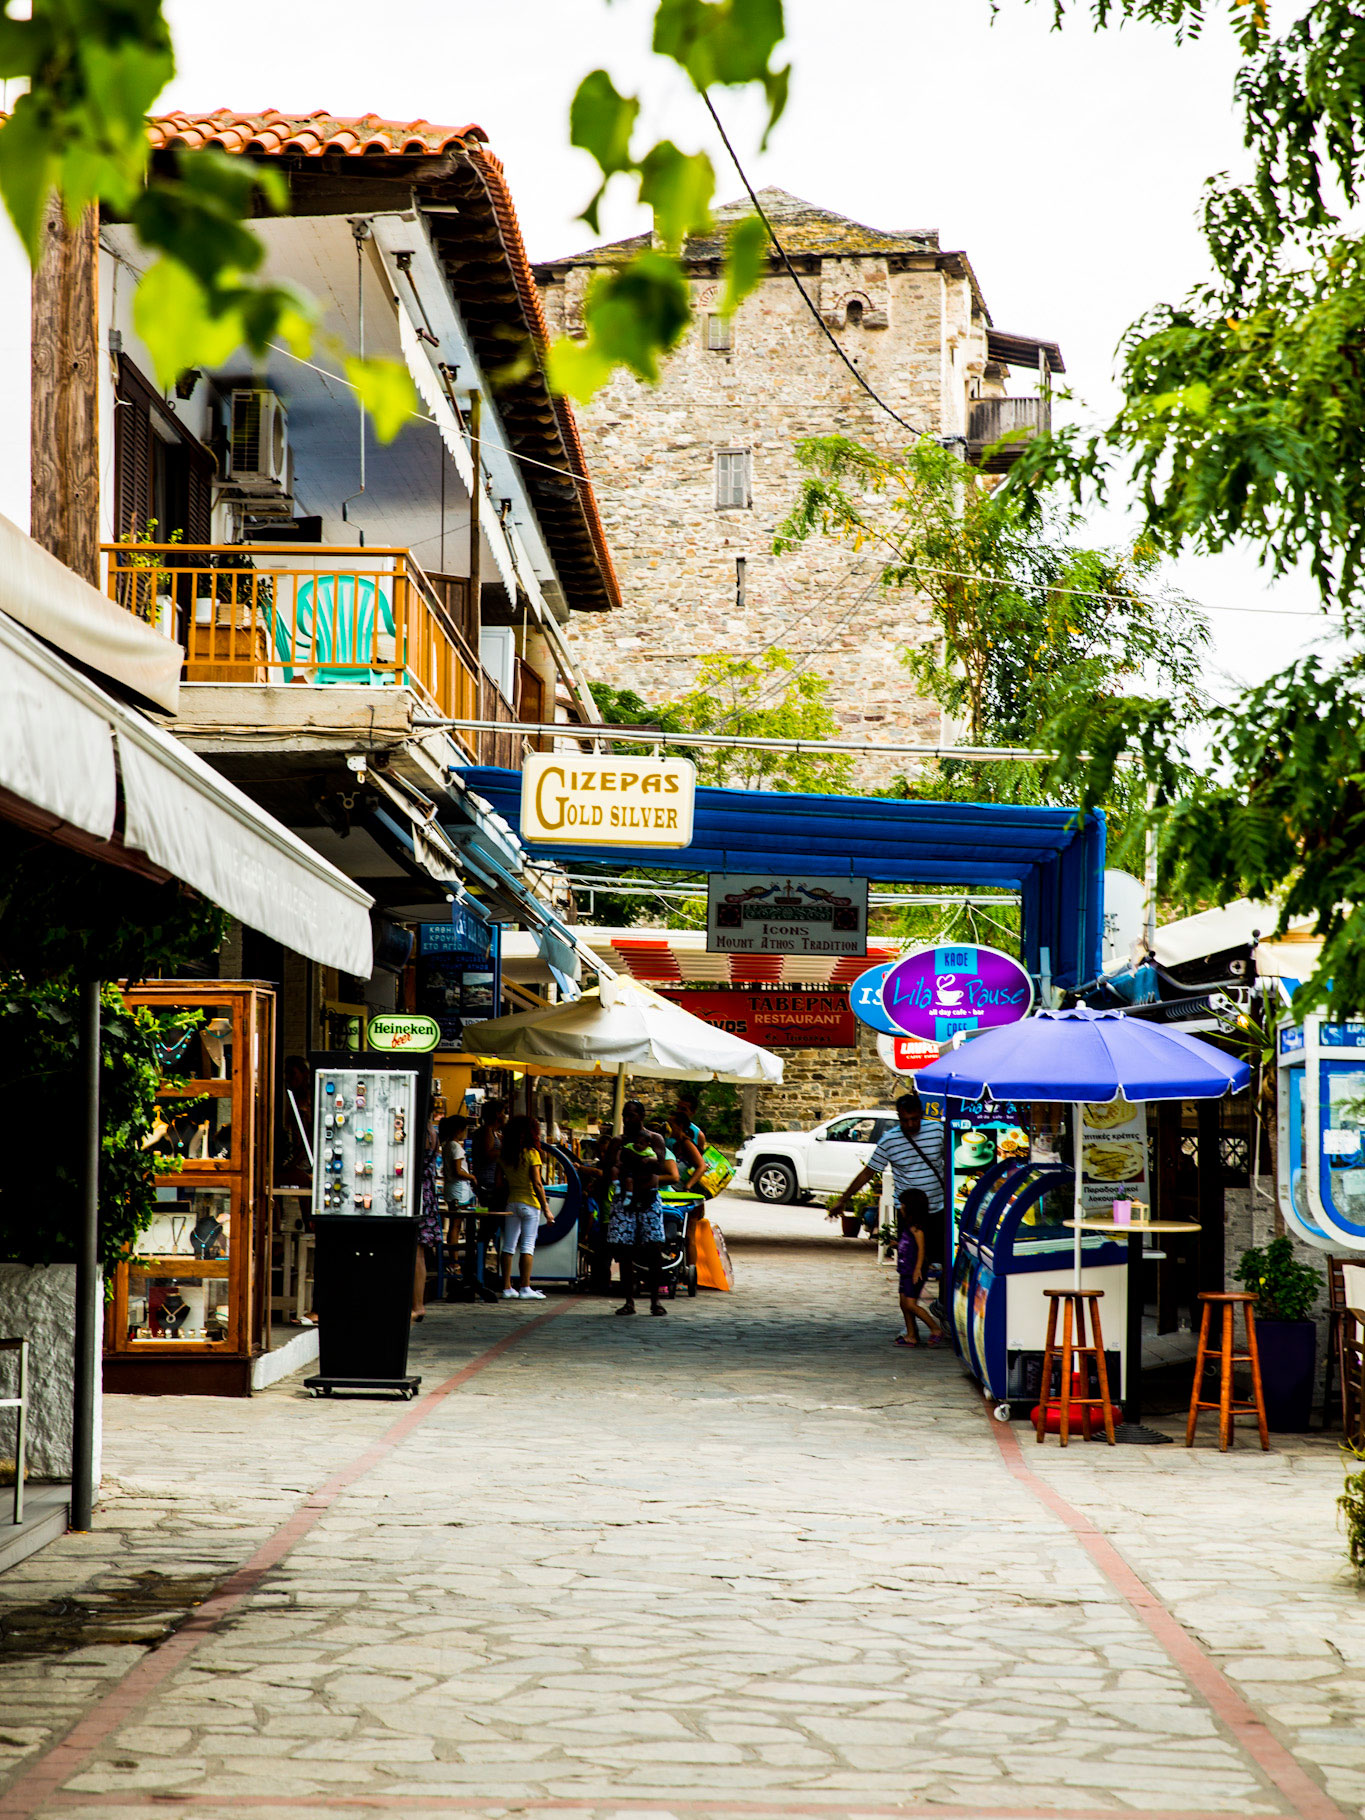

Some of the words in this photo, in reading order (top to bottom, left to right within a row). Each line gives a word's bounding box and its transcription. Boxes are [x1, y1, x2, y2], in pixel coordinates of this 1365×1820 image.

[610, 805, 678, 829] SILVER
[762, 923, 809, 936] ICONS
[716, 936, 754, 949] MOUNT
[760, 937, 795, 950] ATHOS
[801, 937, 858, 951] TRADITION
[944, 952, 968, 967] ΚΑΦΕ
[892, 976, 932, 1009] Lila
[965, 979, 1025, 1008] Pause
[754, 1013, 843, 1025] RESTAURANT
[929, 1008, 938, 1016] all
[938, 1008, 952, 1017] day
[952, 1008, 967, 1016] cafe
[972, 1008, 985, 1016] bar
[374, 1022, 434, 1035] Heineken
[391, 1032, 412, 1049] beer
